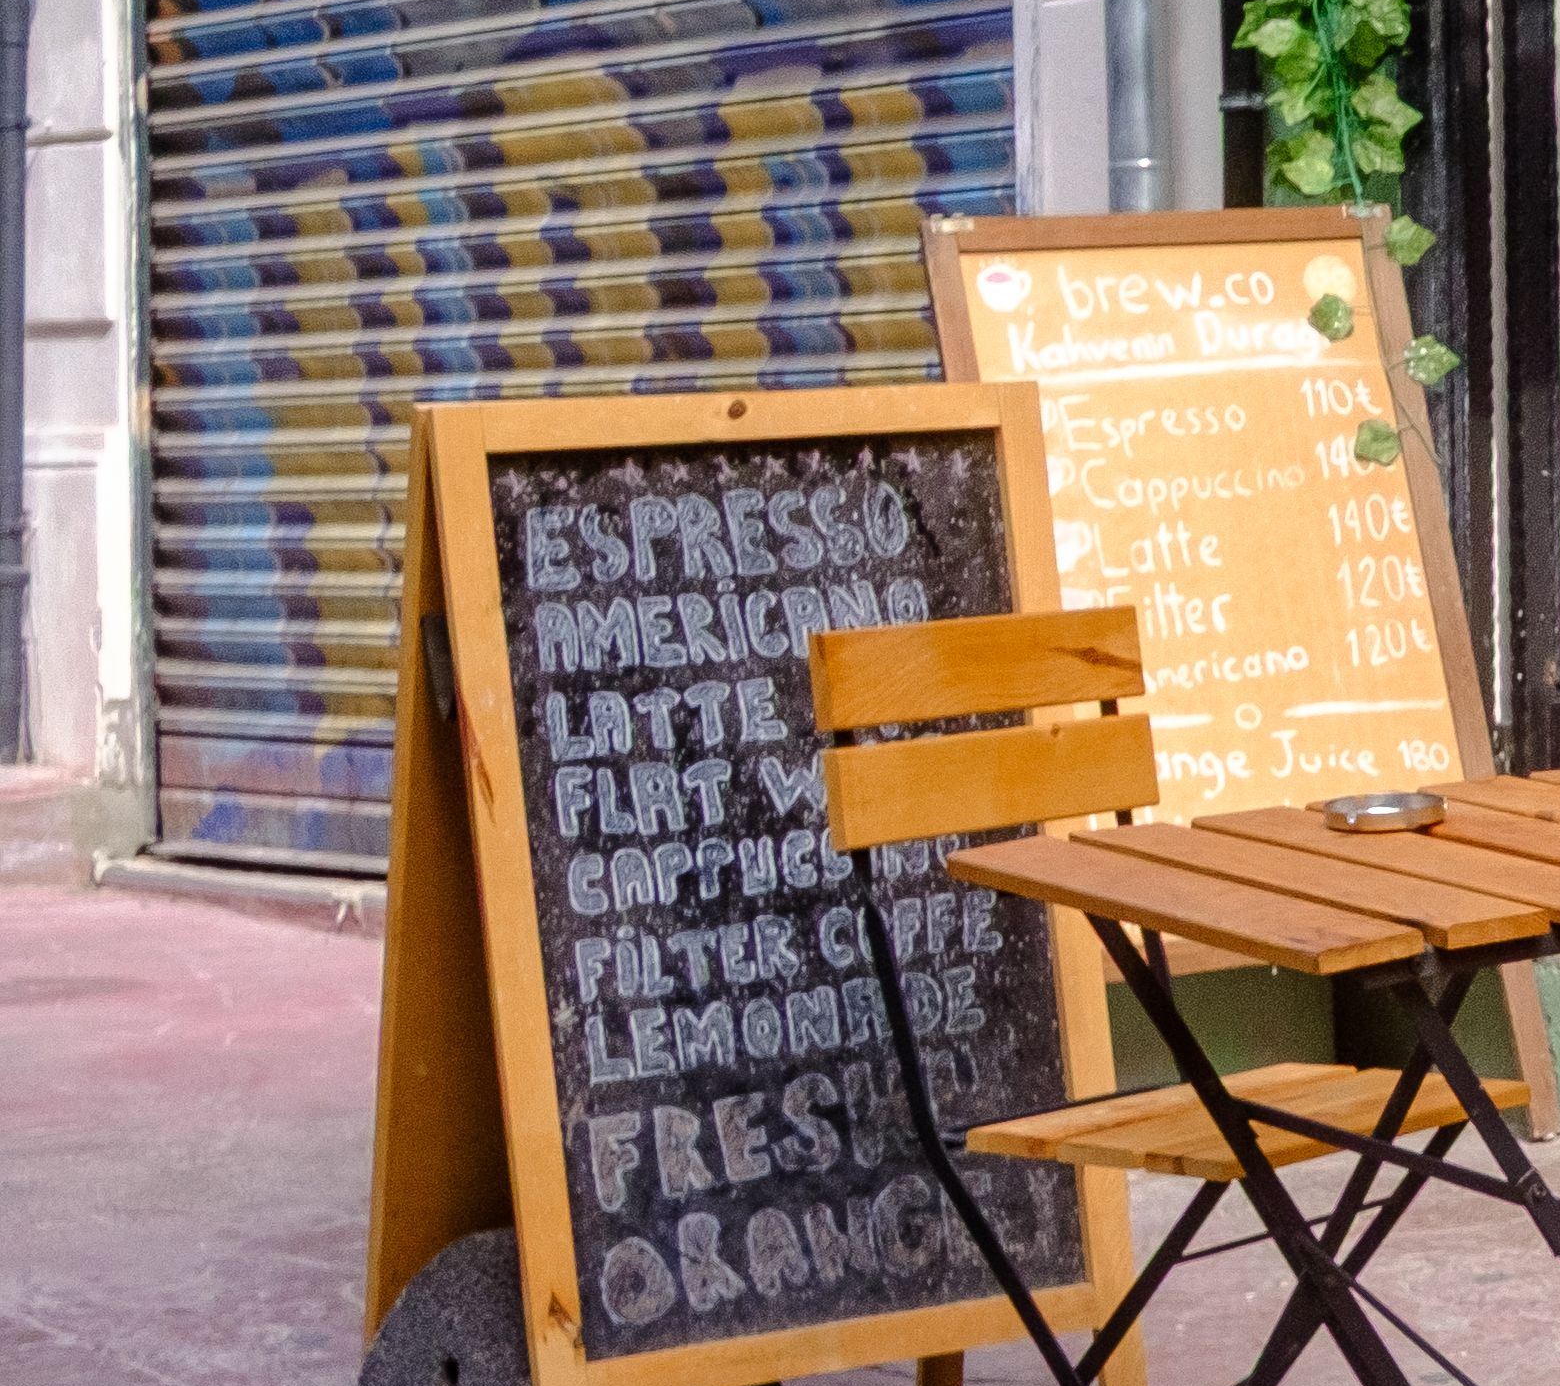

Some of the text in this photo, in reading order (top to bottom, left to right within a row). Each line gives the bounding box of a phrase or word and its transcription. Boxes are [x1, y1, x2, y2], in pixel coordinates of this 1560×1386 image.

[1057, 264, 1274, 319] brew.co
[1060, 393, 1246, 456] Espresso
[1082, 459, 1305, 512] Cappuccino
[527, 481, 910, 592] ESPRESSO
[1093, 523, 1223, 578] Latte
[547, 676, 789, 762] LATTE
[1270, 730, 1380, 777] Juice
[1398, 740, 1450, 772] 180
[555, 758, 732, 837] FLAT
